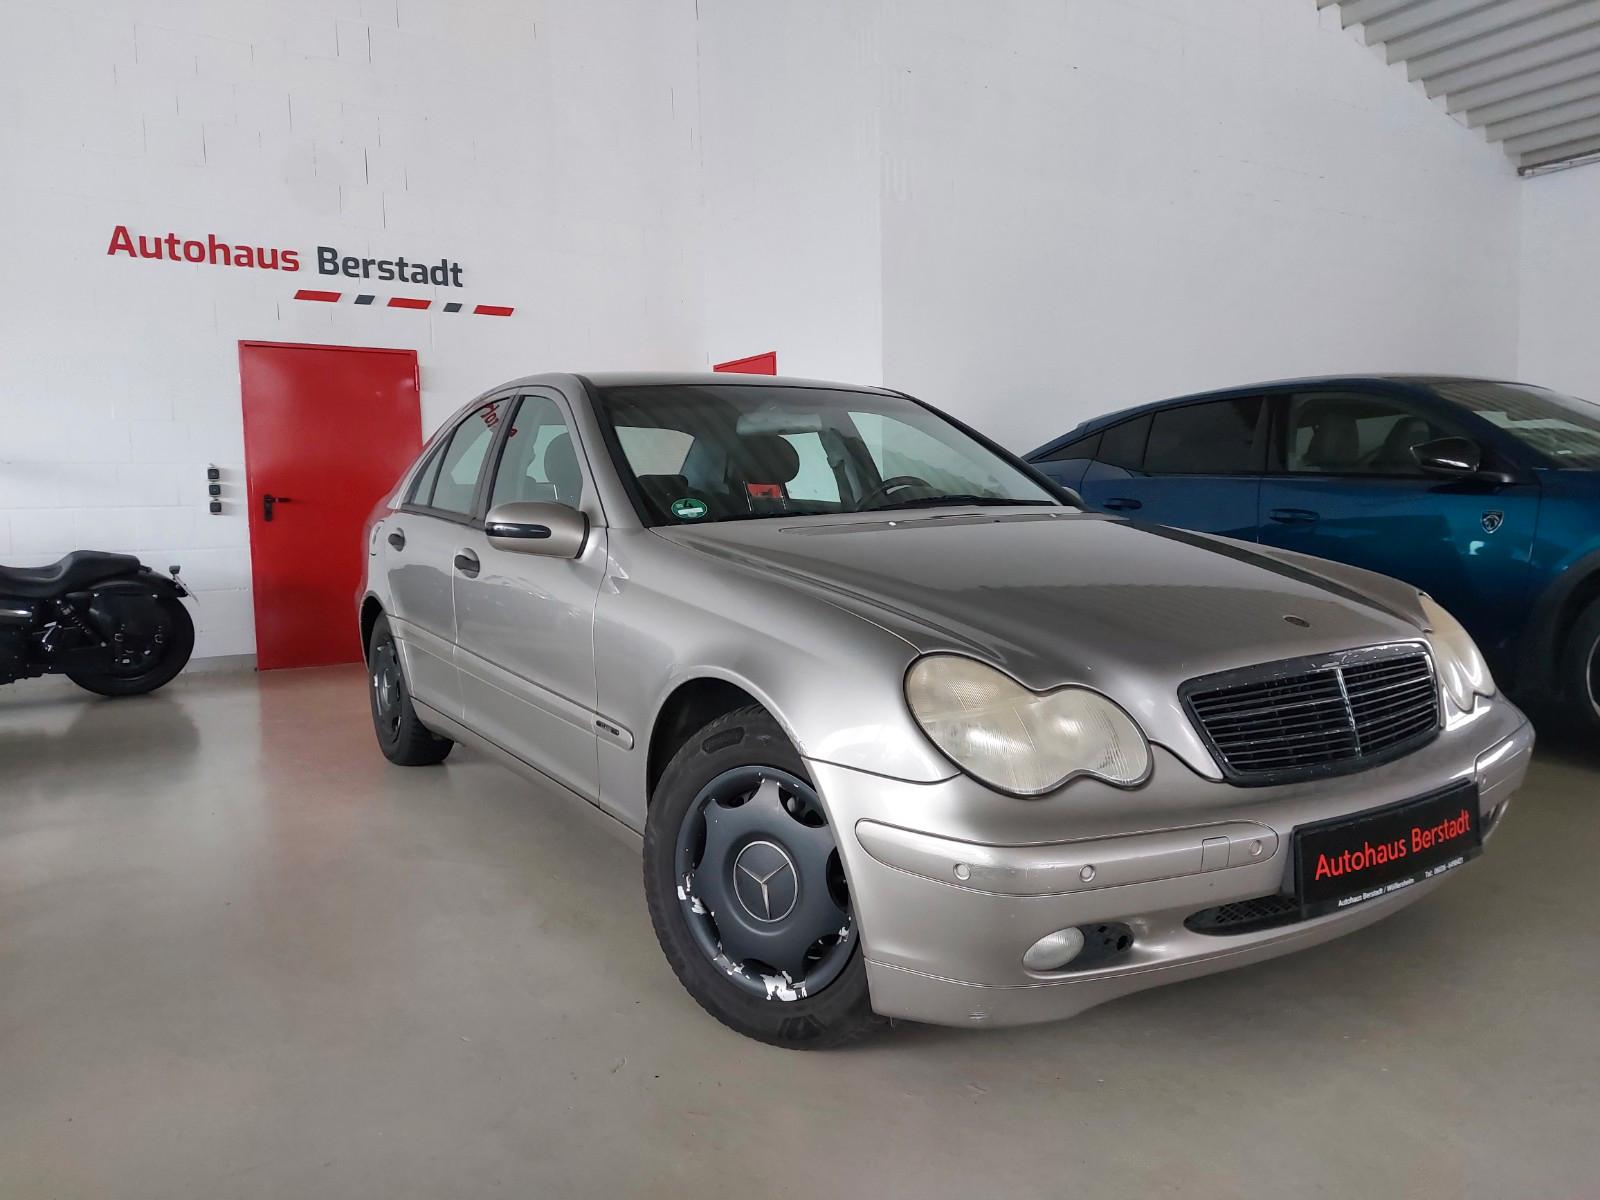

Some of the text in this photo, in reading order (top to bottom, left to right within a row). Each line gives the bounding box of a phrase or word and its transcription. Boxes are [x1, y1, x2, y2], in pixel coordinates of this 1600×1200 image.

[107, 225, 464, 288] Autohaus Berstadt
[1315, 838, 1407, 881] Autohaus
[1411, 809, 1471, 853] Berstadt
[1338, 895, 1362, 907] Autohaus
[1362, 886, 1383, 900] Berstadt
